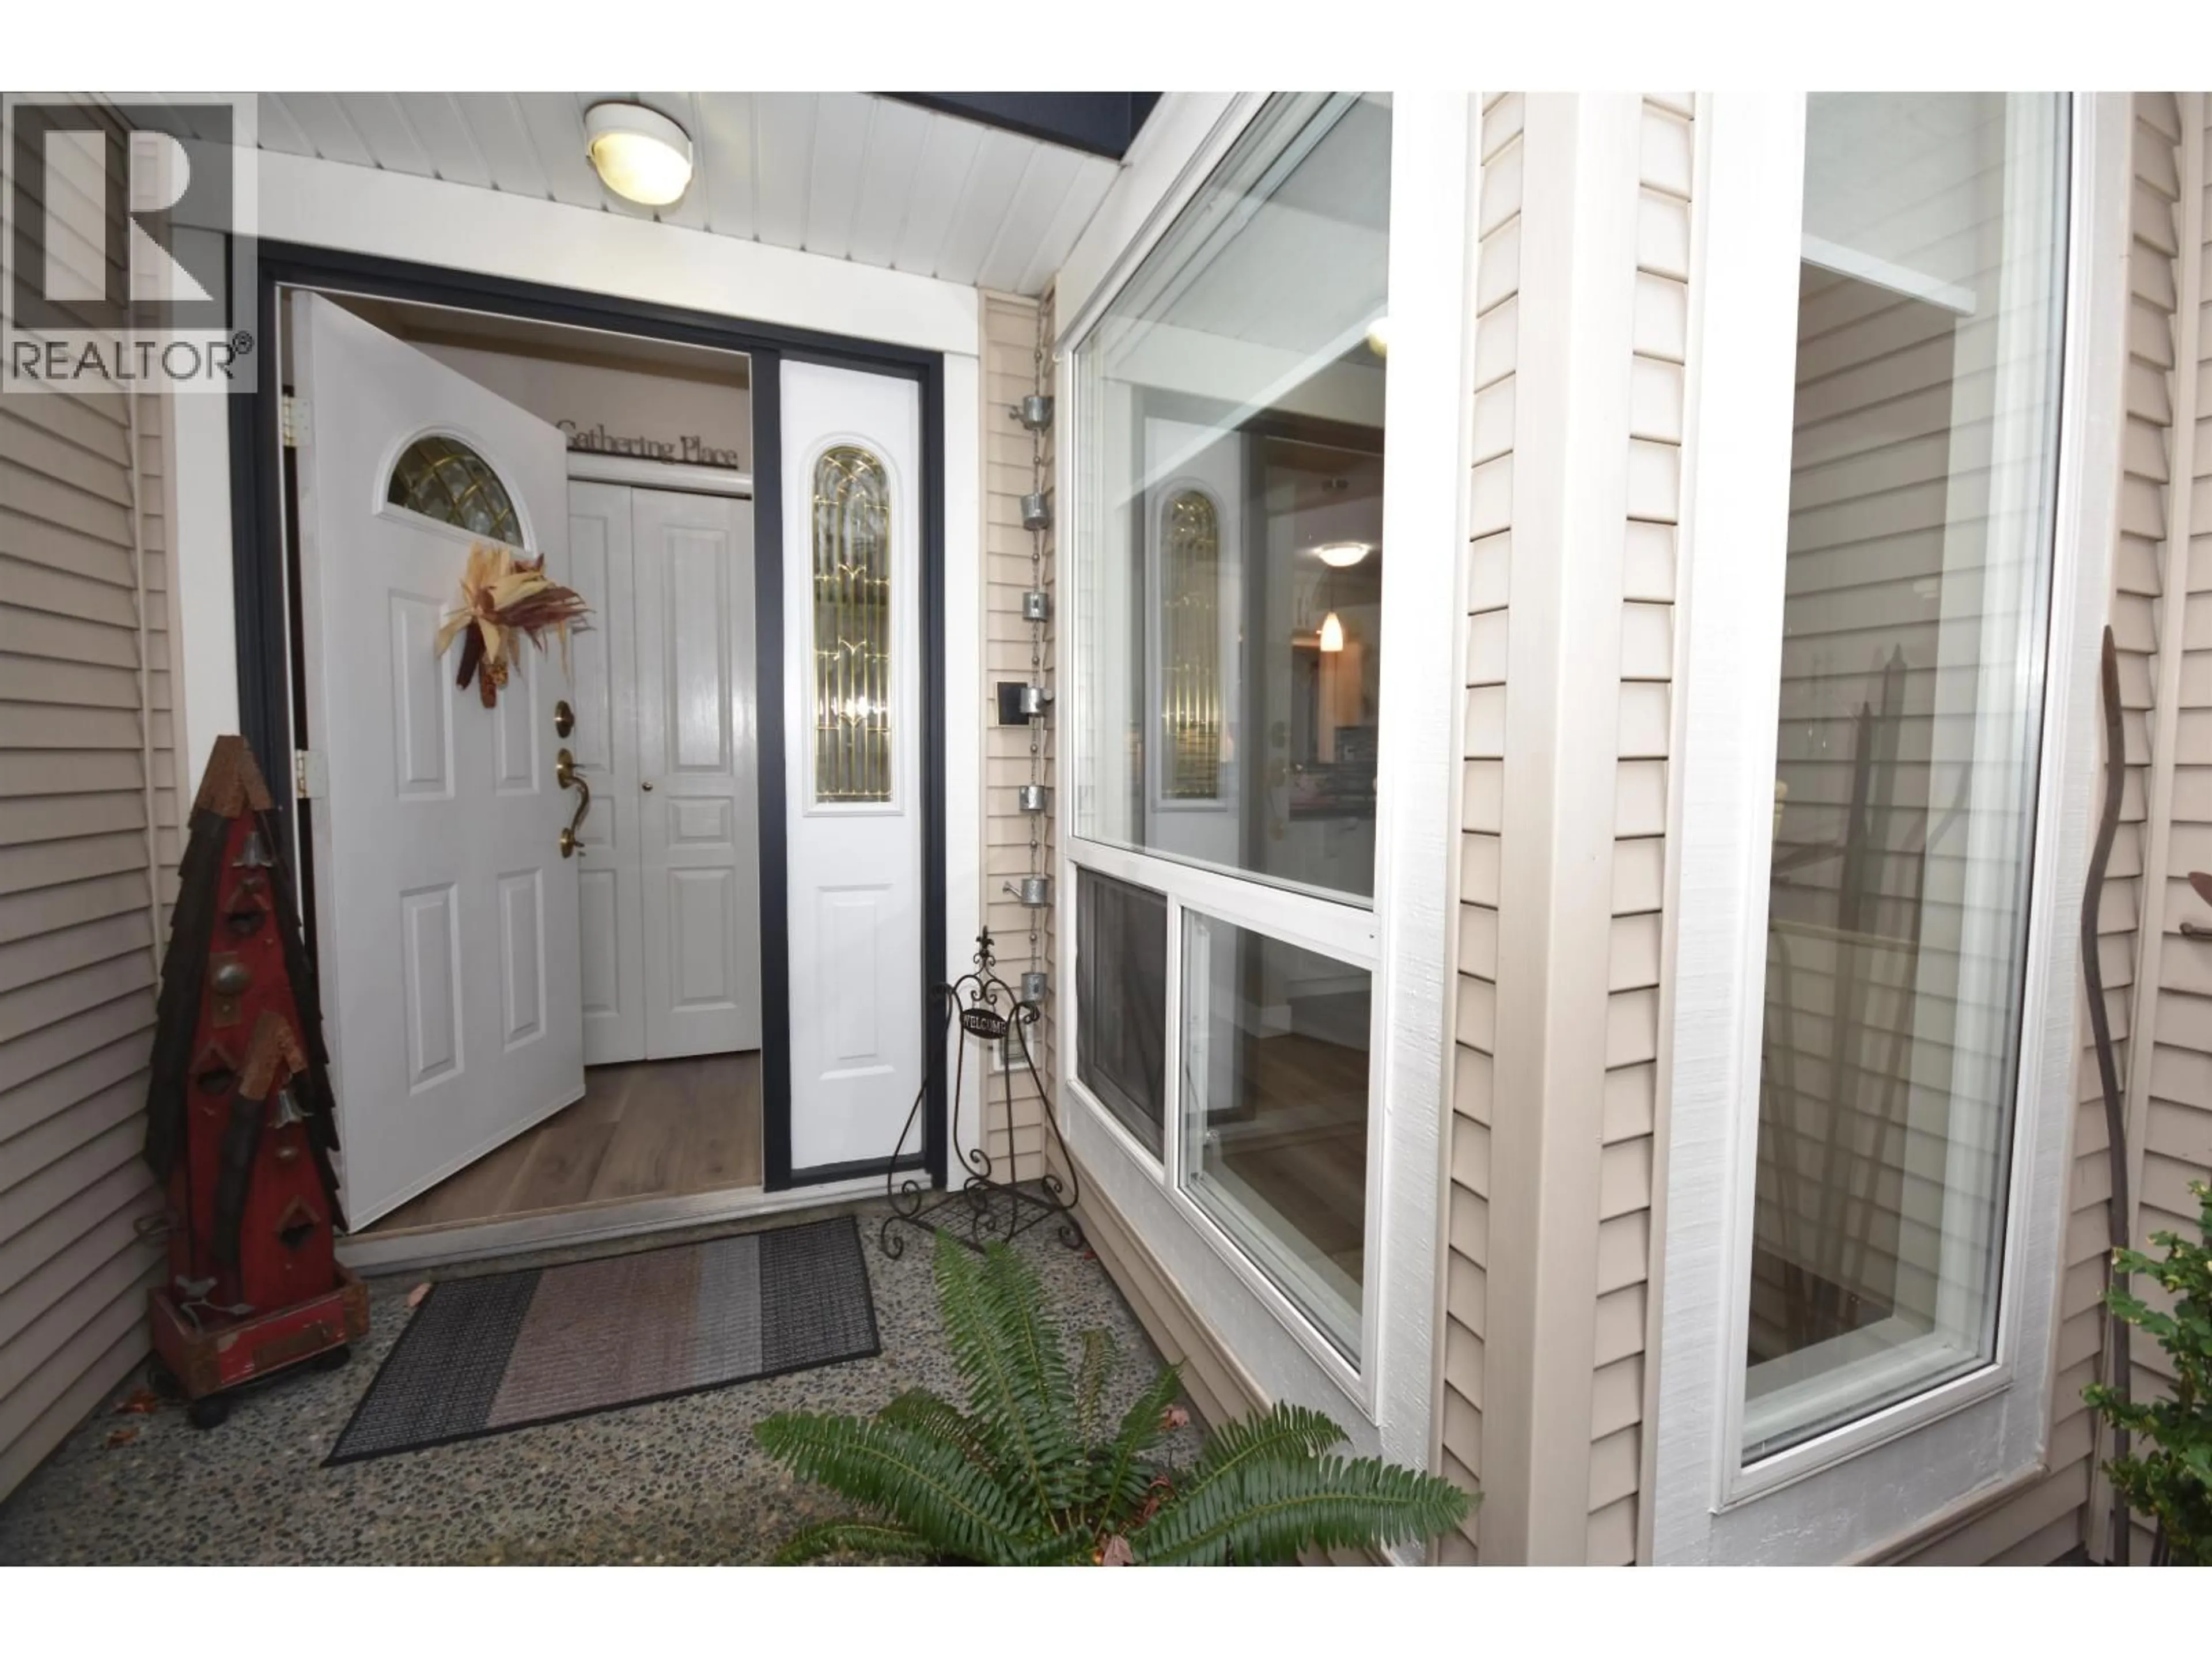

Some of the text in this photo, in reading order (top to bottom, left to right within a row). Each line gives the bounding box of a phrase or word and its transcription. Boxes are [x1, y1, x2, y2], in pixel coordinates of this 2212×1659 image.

[556, 419, 738, 469] Gathering Place
[963, 1016, 1007, 1035] WELCOME
